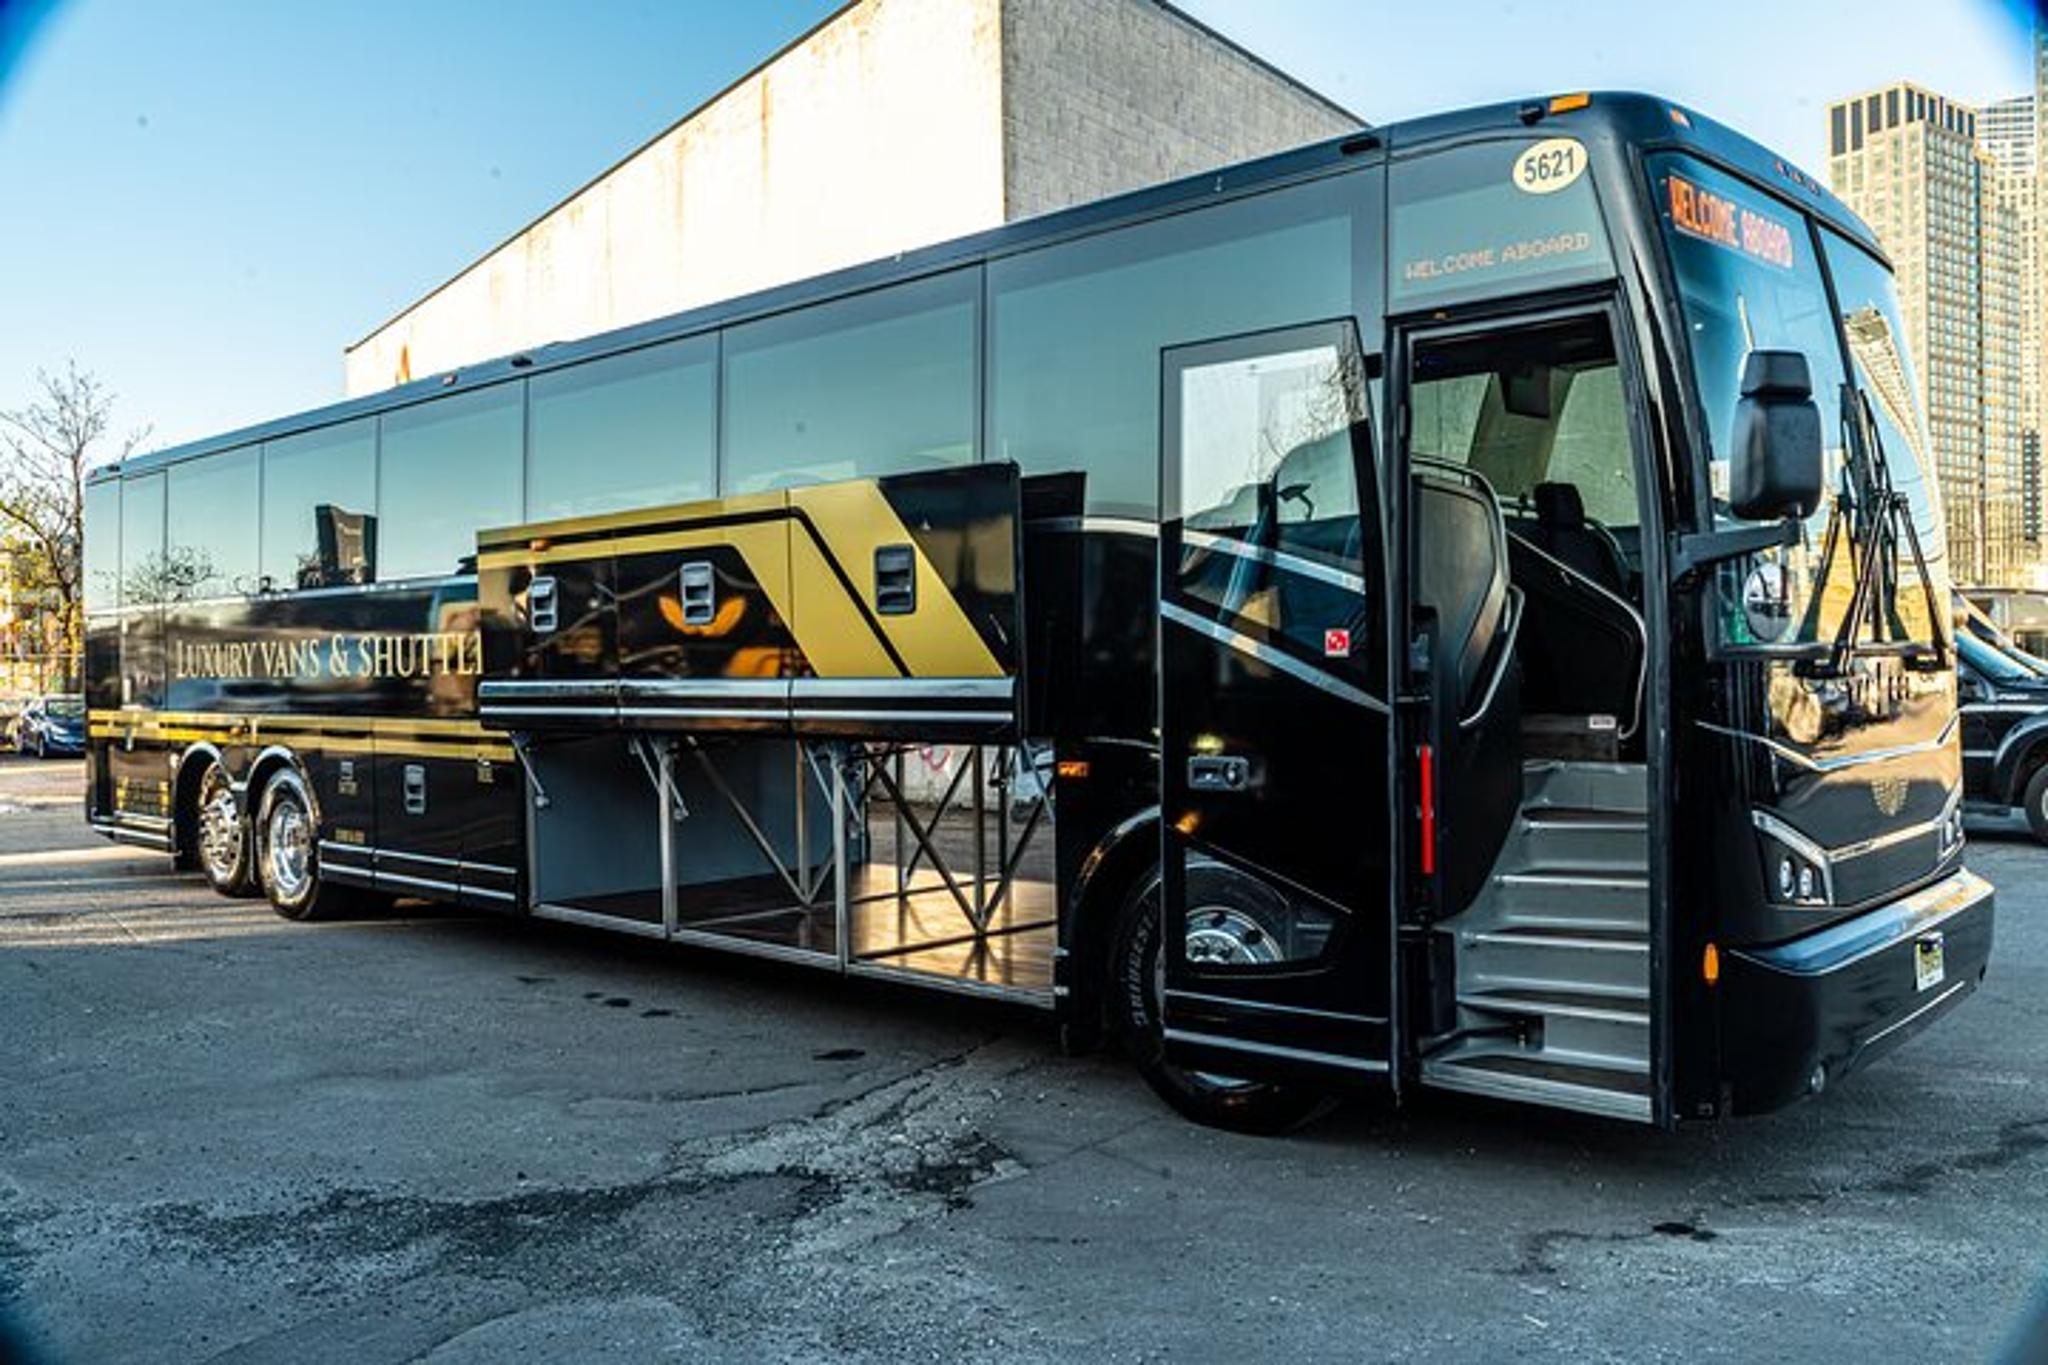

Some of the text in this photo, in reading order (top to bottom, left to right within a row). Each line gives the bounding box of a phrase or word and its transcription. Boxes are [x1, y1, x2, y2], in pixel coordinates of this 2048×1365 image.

[1523, 147, 1575, 184] 5621
[1502, 232, 1590, 263] ABOARD
[176, 640, 257, 678] LUXURY
[261, 639, 320, 677] VANS
[329, 633, 351, 678] &
